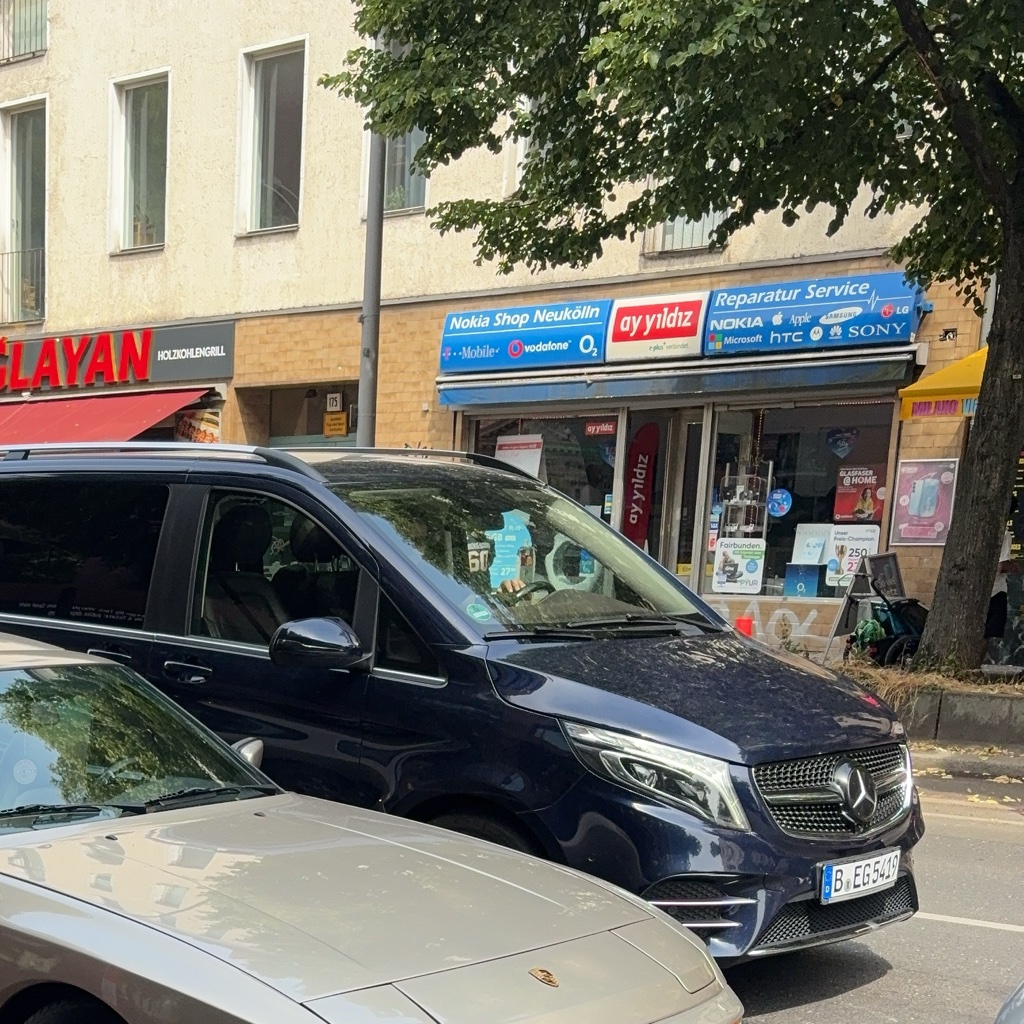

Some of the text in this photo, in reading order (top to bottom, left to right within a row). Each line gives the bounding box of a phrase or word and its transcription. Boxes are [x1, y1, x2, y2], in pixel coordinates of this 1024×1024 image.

[715, 281, 870, 309] Reparatur Service
[450, 305, 600, 330] Nokia Shop Neukölln
[620, 314, 643, 337] ay
[710, 306, 909, 331] NOKIA Apple SAMSUNG LG
[724, 333, 763, 345] Microsoft
[848, 322, 906, 338] SONY
[157, 345, 226, 361] HOLZKOHLENGRILL
[525, 341, 568, 353] vodafone
[328, 396, 338, 408] 175
[848, 548, 868, 558] 250
[834, 868, 844, 893] B
[853, 863, 871, 889] EG
